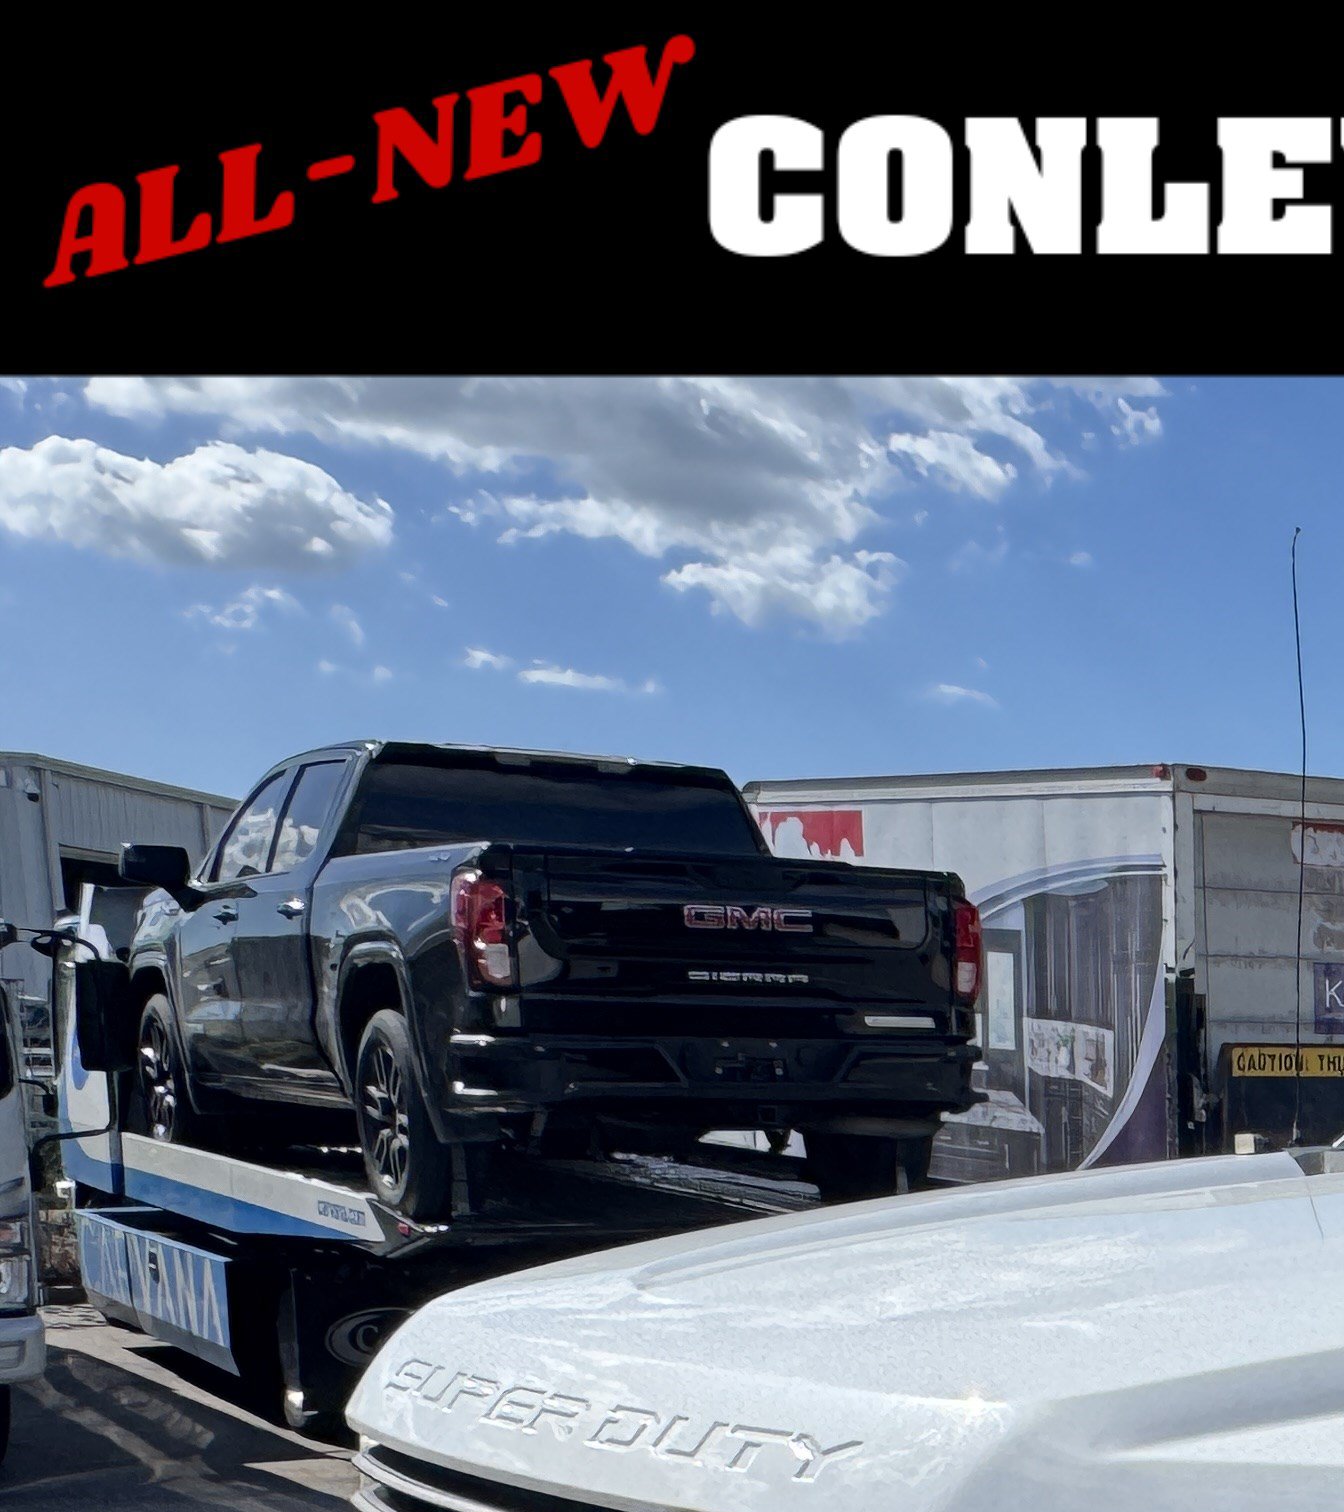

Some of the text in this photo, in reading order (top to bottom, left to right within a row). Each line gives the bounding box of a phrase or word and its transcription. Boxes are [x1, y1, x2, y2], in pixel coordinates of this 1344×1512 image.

[684, 904, 813, 932] GMC
[688, 971, 809, 983] SIERRA
[385, 1358, 864, 1483] SUPER DUTY
